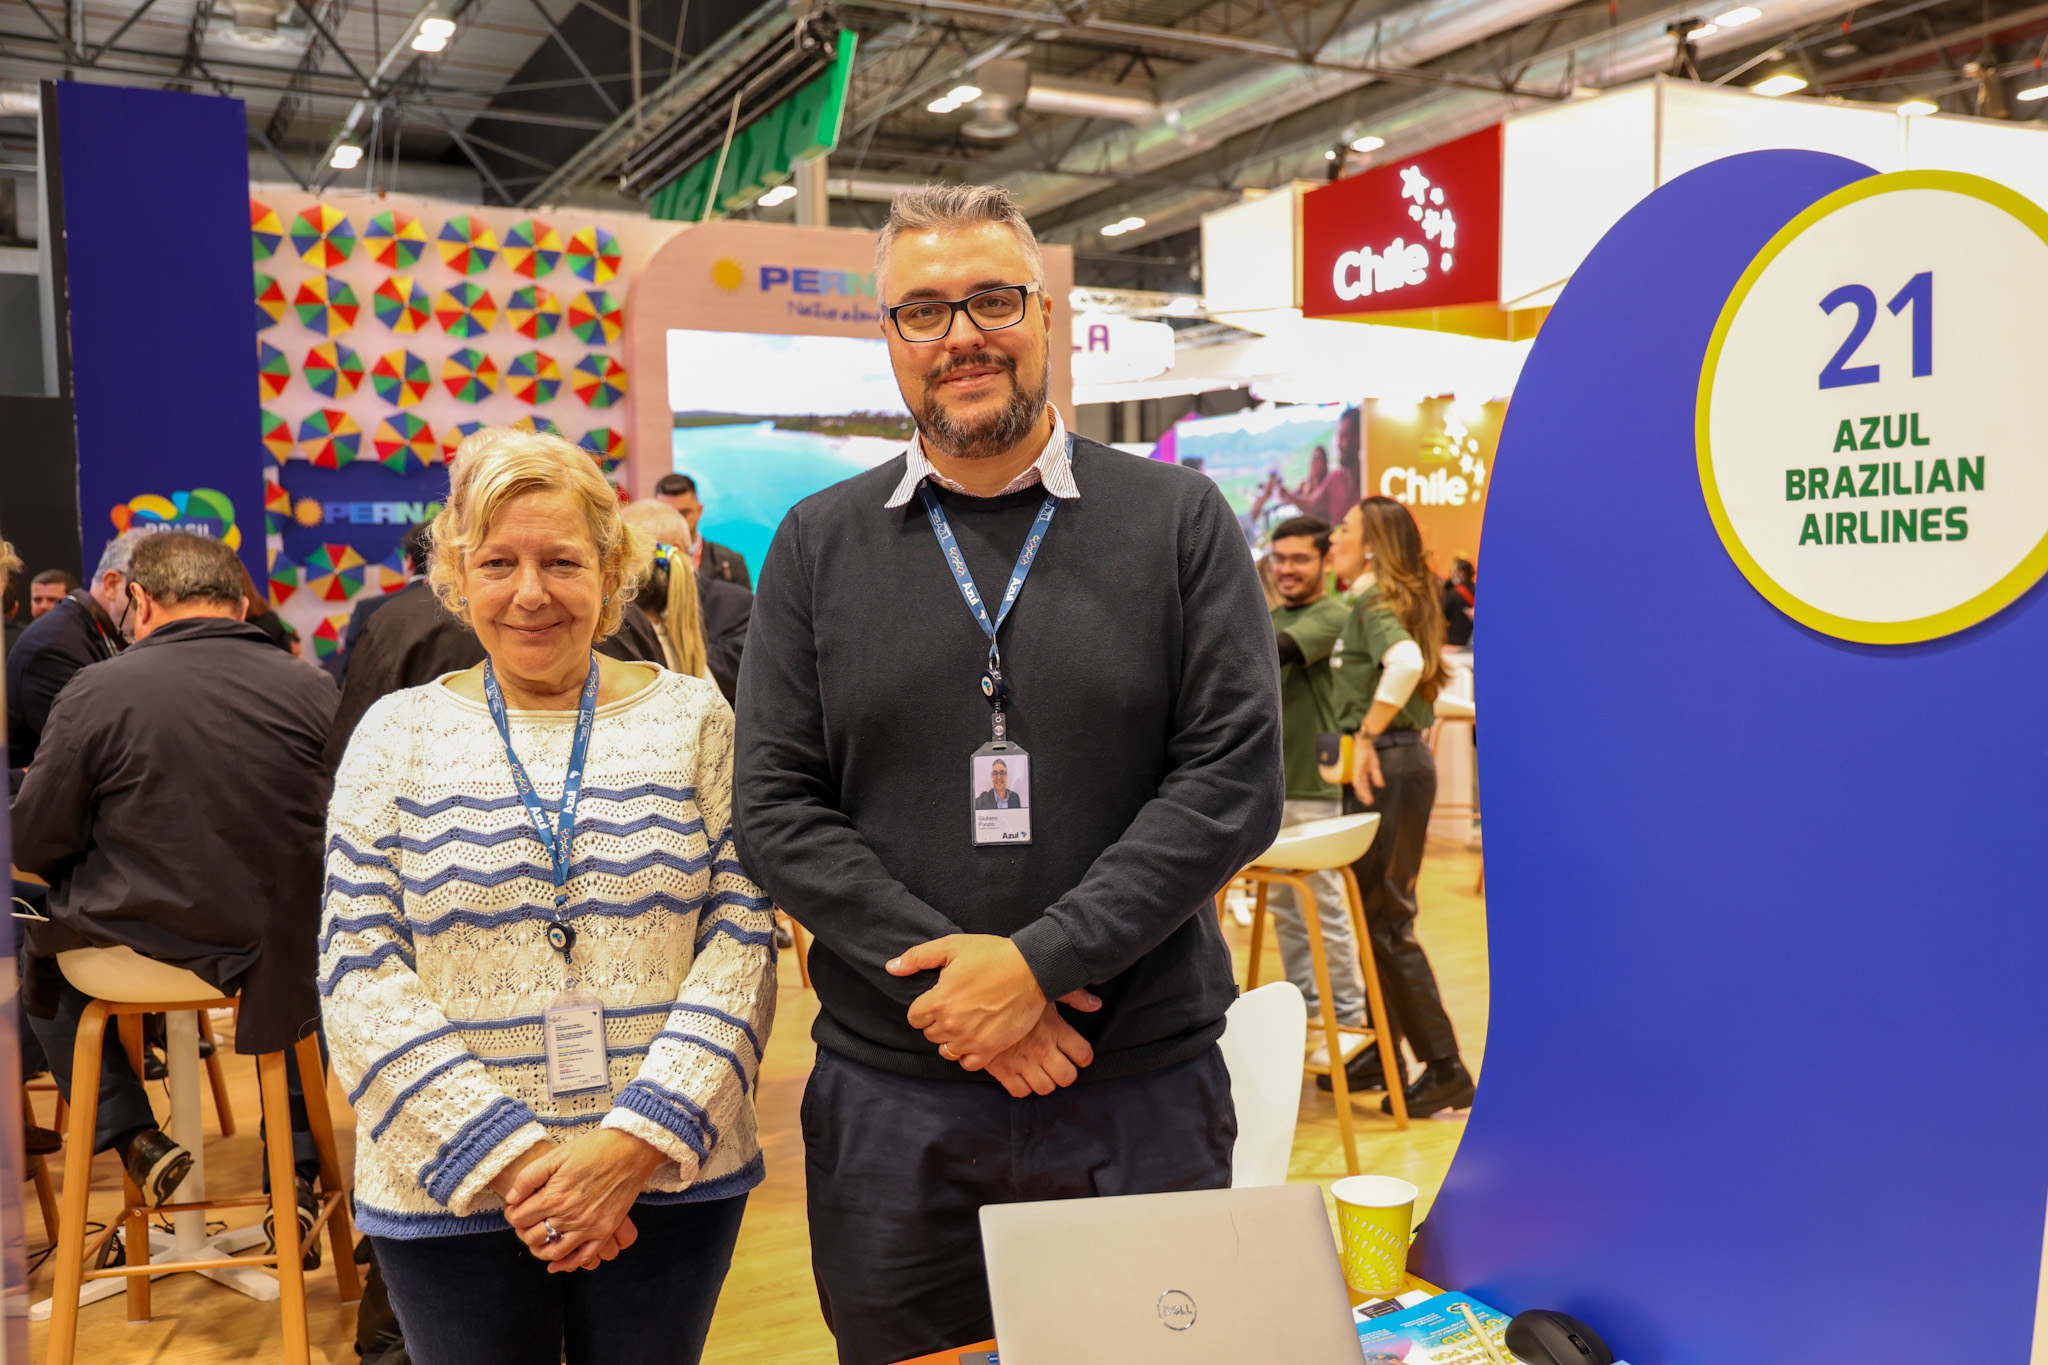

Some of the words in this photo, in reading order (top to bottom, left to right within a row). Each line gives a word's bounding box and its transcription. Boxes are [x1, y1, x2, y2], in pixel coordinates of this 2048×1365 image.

[1333, 237, 1429, 301] Chile
[1818, 270, 1933, 390] 21
[1832, 412, 1930, 453] AZUL
[1380, 466, 1469, 506] Chile
[1785, 455, 1985, 501] BRAZILIAN
[1798, 506, 1968, 546] AIRLINES
[962, 582, 980, 606] Azul
[1005, 577, 1022, 602] Azul
[529, 806, 550, 830] Azul
[563, 790, 578, 814] Azul
